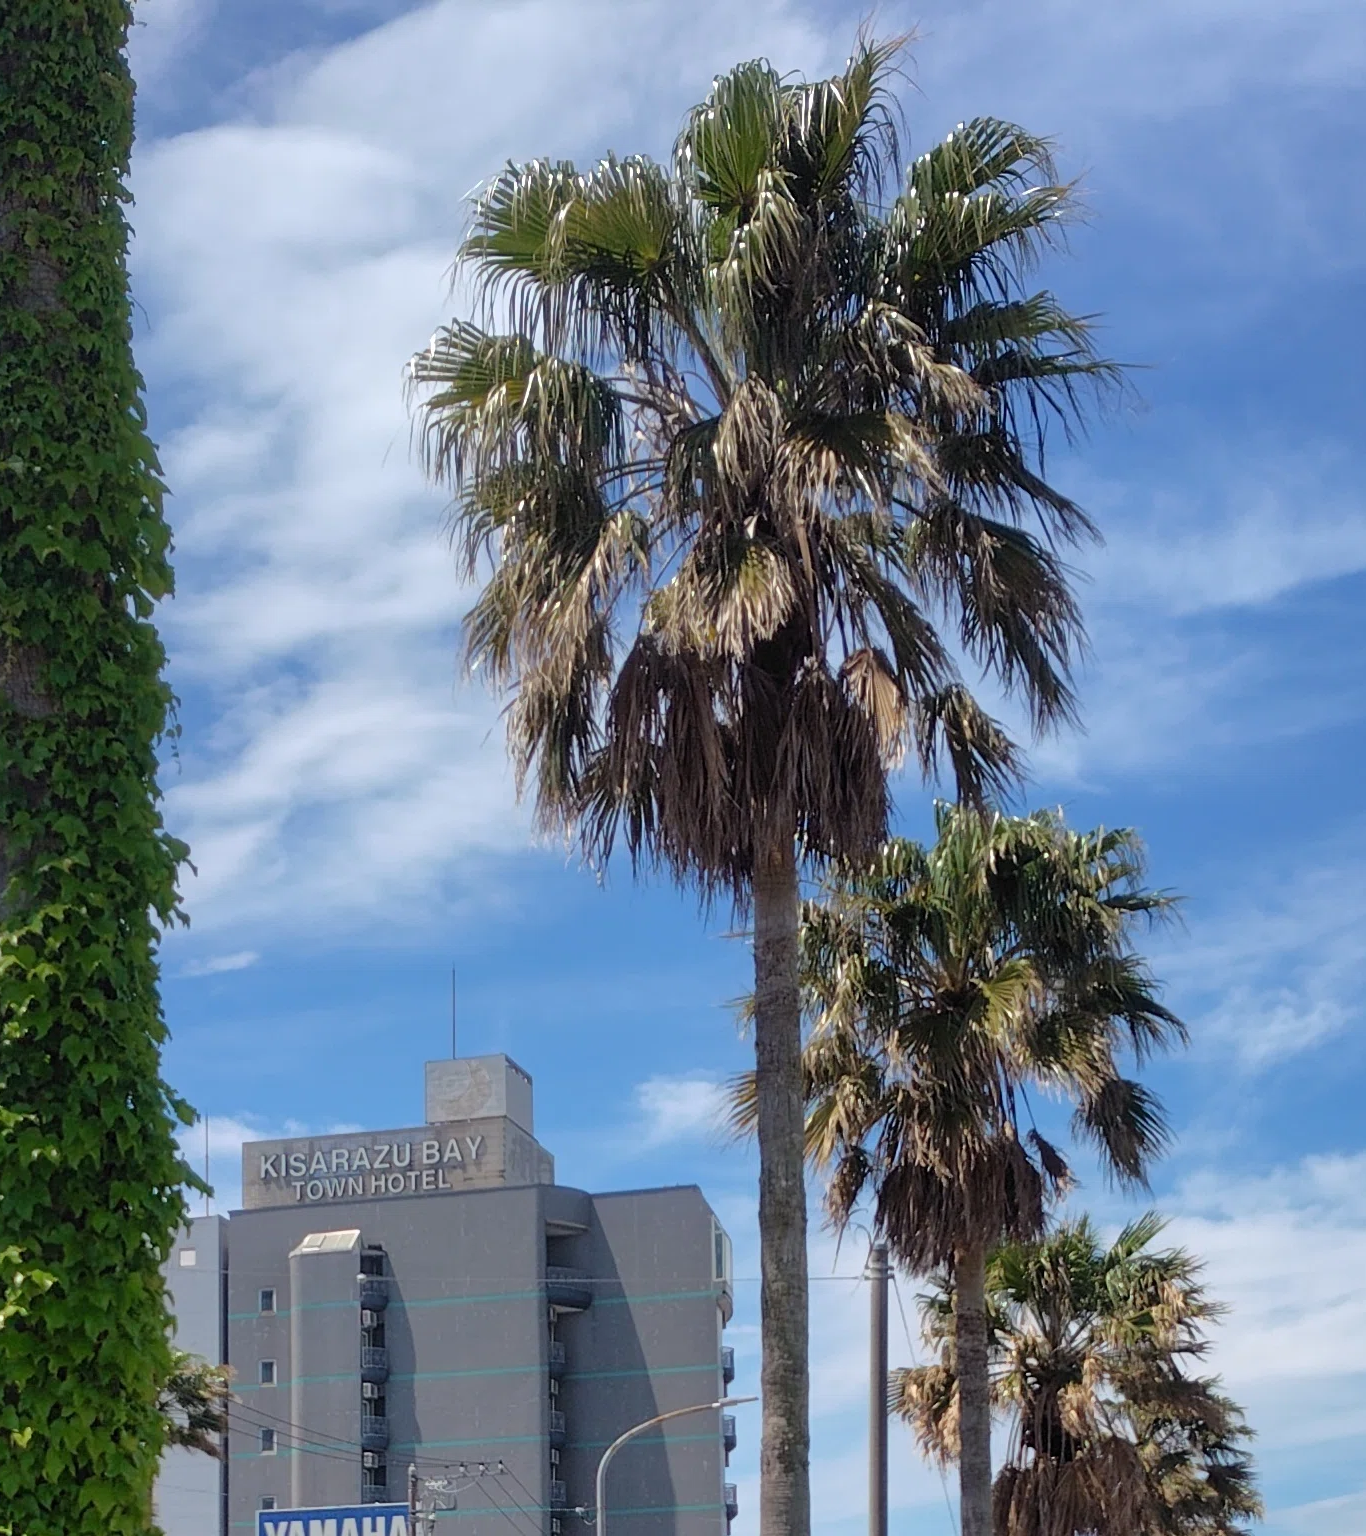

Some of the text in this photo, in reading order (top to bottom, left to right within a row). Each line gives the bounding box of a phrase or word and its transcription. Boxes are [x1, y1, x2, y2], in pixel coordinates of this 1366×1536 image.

[260, 1135, 484, 1179] KISARAZU BAY
[292, 1168, 452, 1201] TOWN HOTEL
